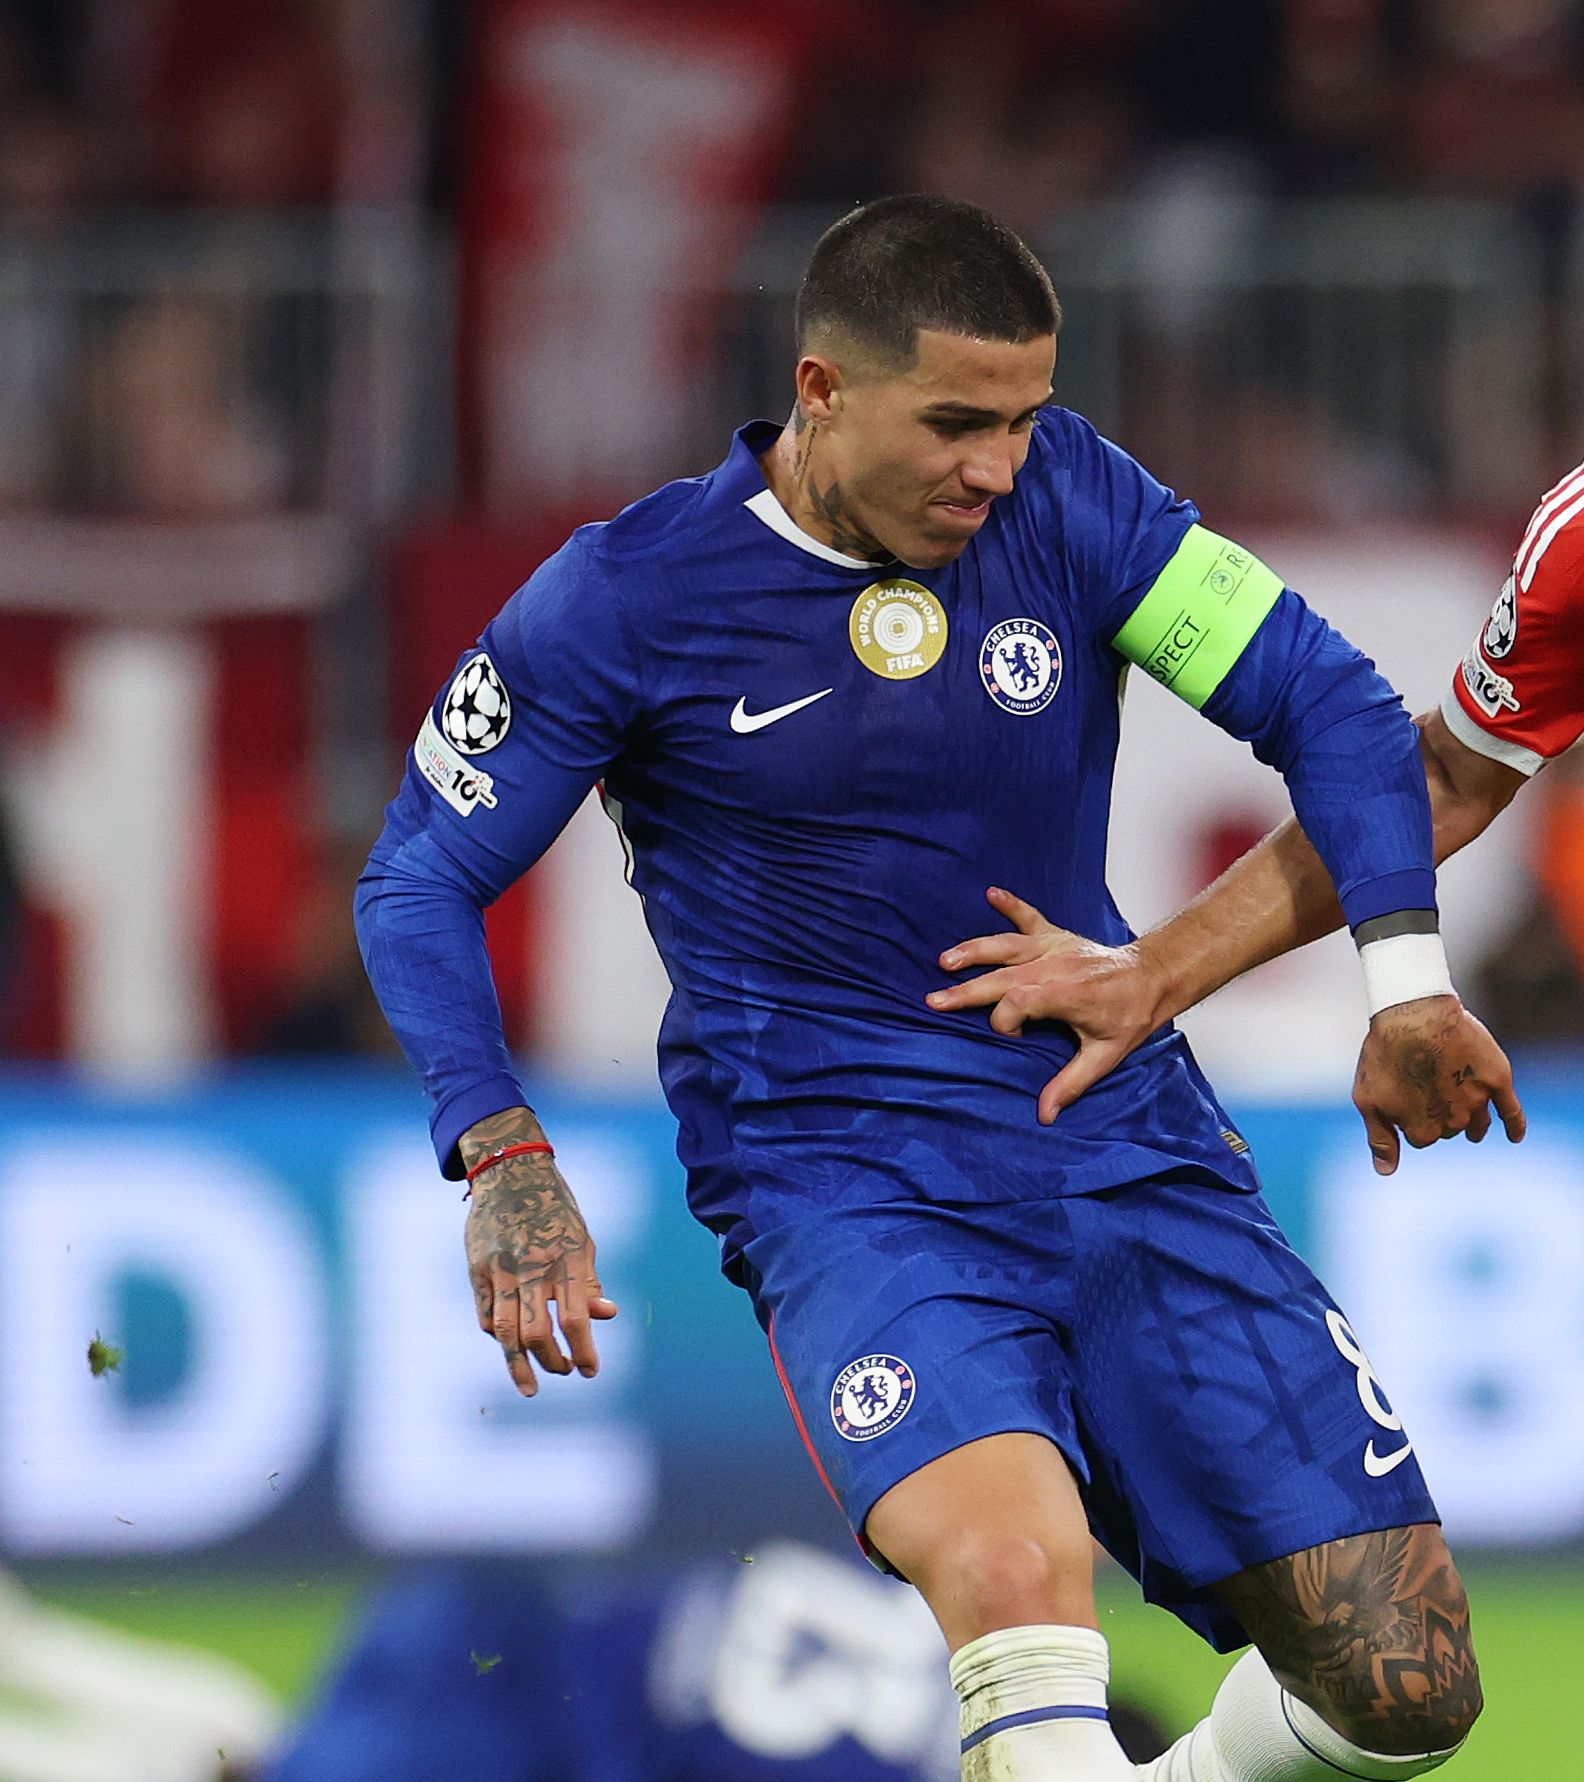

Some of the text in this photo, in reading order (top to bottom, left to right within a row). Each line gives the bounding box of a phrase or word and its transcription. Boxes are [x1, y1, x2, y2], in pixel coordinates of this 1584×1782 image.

[858, 587, 939, 647] WORLD CHAMPIONS
[986, 622, 1038, 652] CHELSEA
[1150, 615, 1201, 682] SPECT
[886, 652, 925, 672] FIFA
[836, 1357, 887, 1394] CHELSEA
[1325, 1308, 1402, 1431] 8
[855, 1399, 907, 1436] FOOTBALL CLUB
